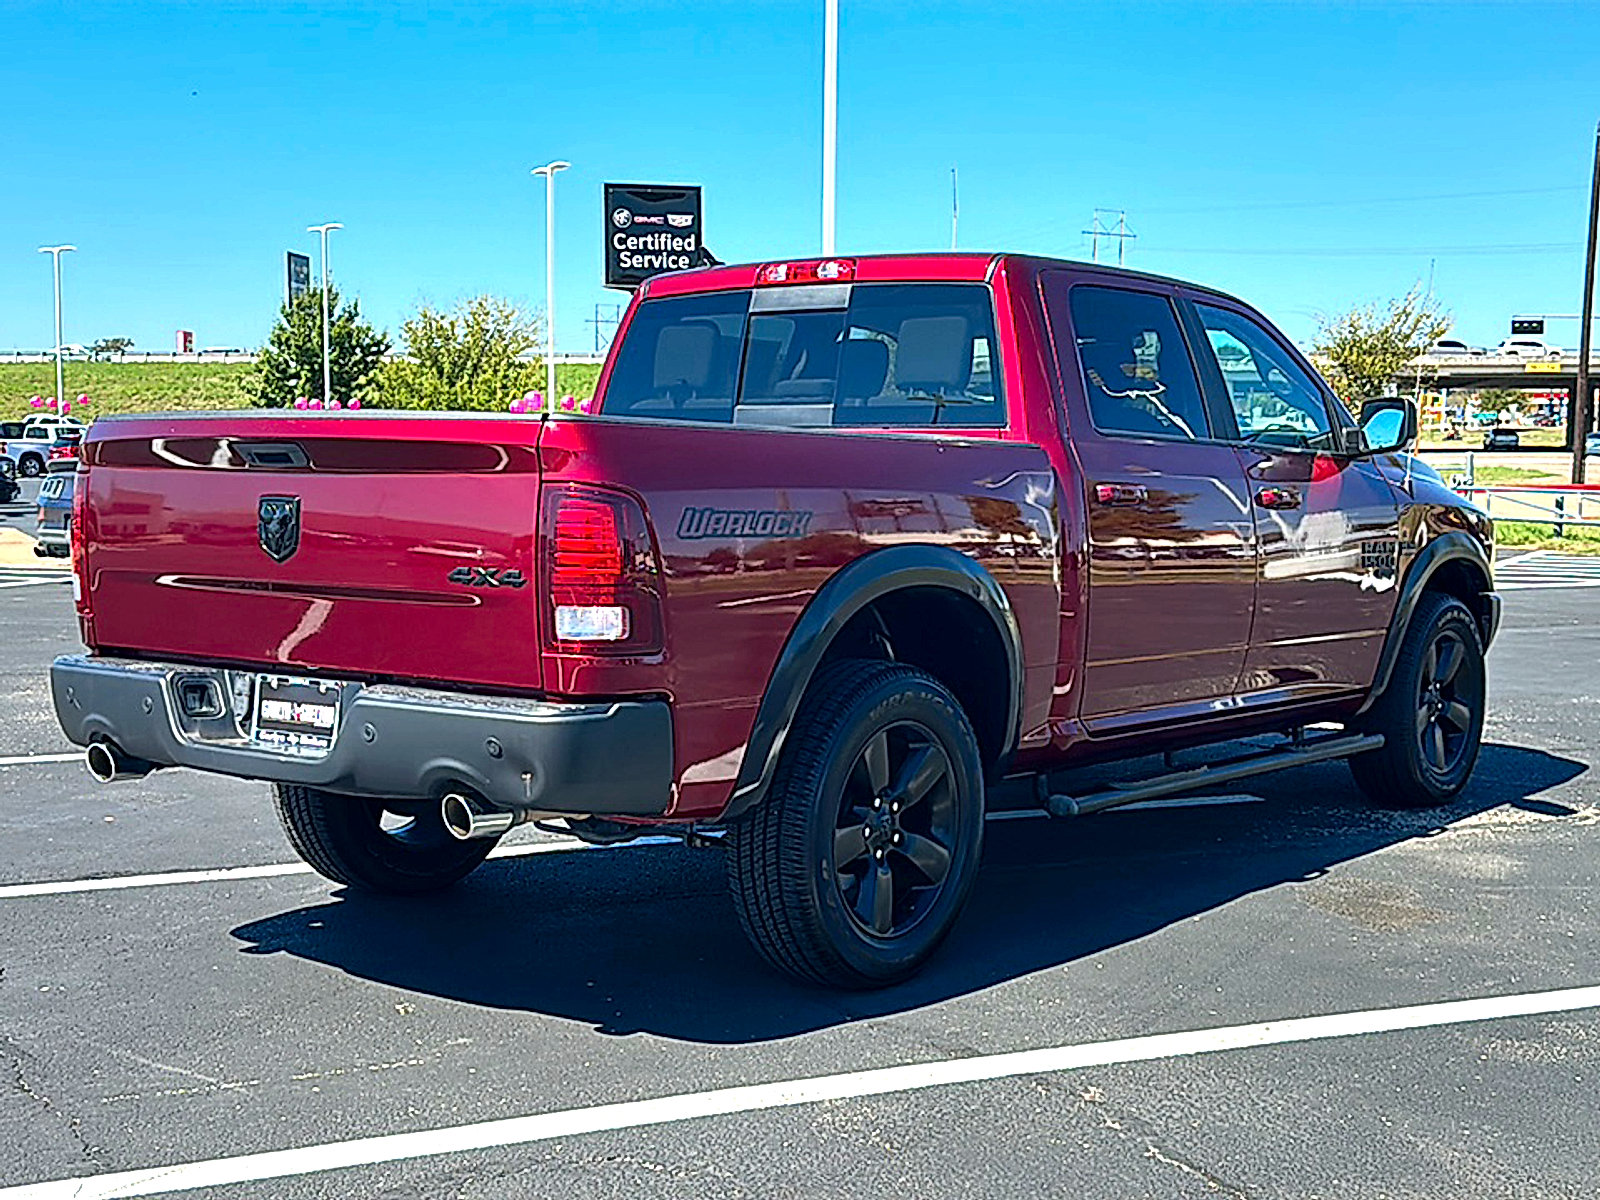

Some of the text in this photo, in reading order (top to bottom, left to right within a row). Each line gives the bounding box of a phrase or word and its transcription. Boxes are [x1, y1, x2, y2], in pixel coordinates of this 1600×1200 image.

[633, 216, 664, 225] GMC
[613, 232, 696, 252] Certified
[619, 251, 690, 269] Service
[677, 507, 813, 540] WARLOCK
